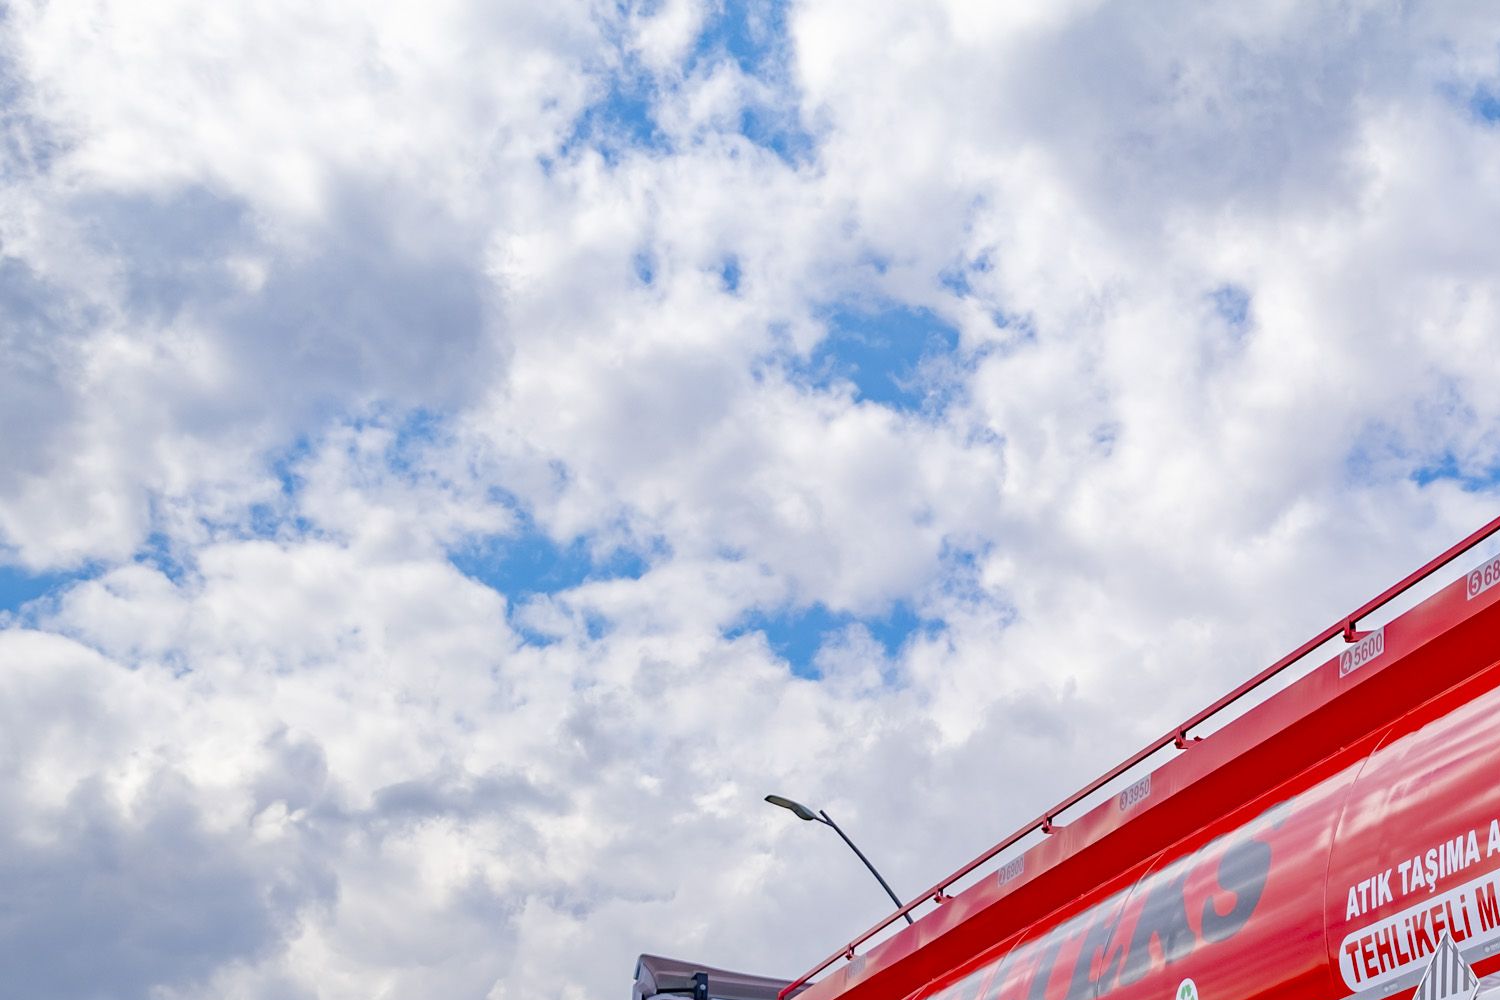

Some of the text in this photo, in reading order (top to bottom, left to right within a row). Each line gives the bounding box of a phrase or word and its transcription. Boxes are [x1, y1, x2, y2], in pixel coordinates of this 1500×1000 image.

[1354, 632, 1382, 666] 5600
[1129, 778, 1150, 805] 3950
[1344, 868, 1394, 921] ATIK
[1397, 829, 1481, 893] TAŞIMA
